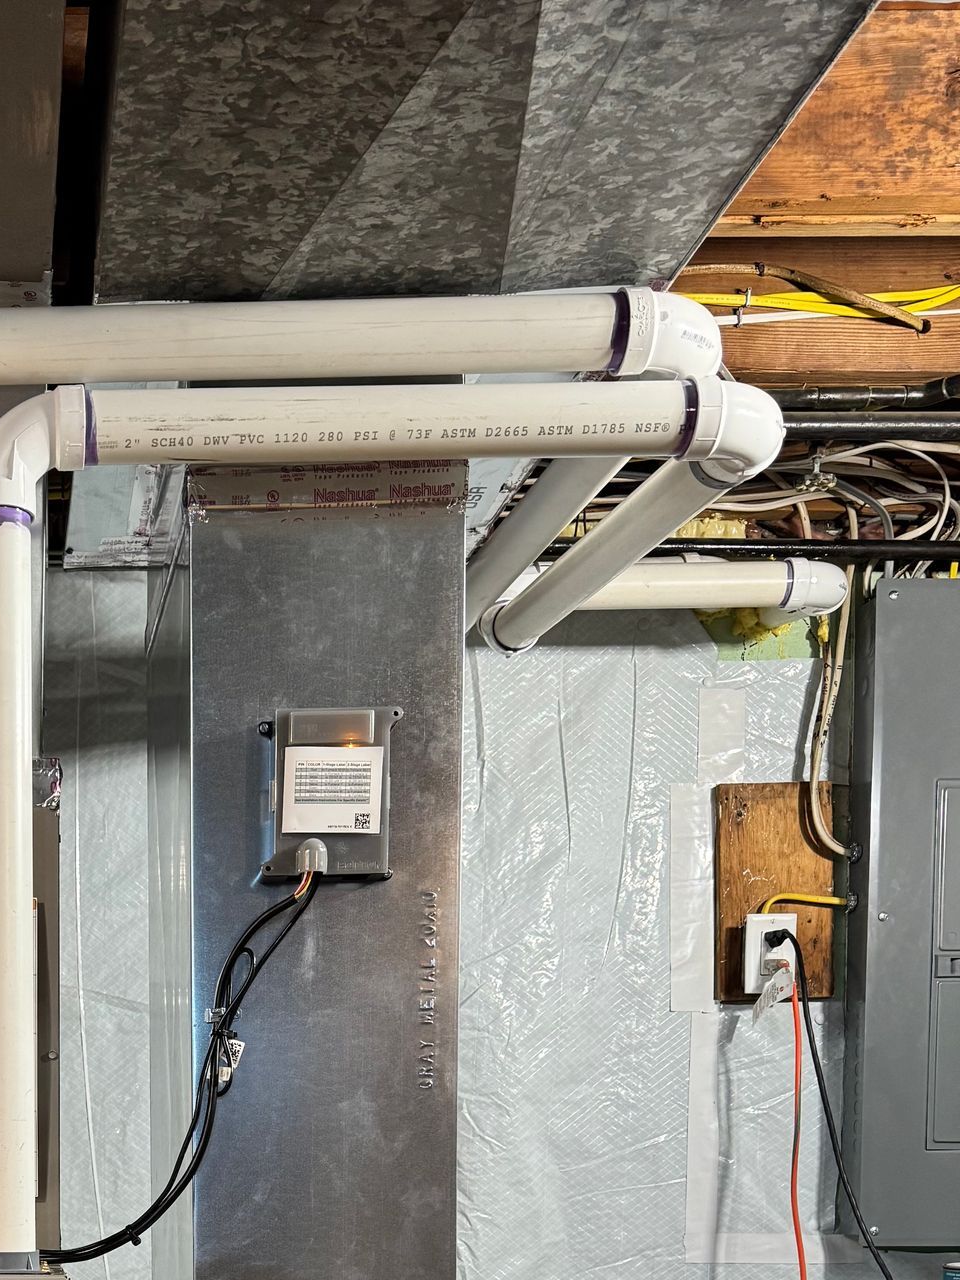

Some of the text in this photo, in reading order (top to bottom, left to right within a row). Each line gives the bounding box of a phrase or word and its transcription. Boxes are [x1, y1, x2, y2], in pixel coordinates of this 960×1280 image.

[150, 435, 194, 448] SCH40
[203, 435, 230, 446] DWV
[239, 433, 266, 445] PVC
[274, 432, 309, 444] 1120
[318, 431, 344, 443] 280
[353, 430, 380, 442] PSI
[406, 429, 433, 440] 73F
[440, 427, 477, 439] ASTM
[485, 426, 530, 438] D2665
[537, 425, 574, 436] ASTM
[582, 423, 626, 434] D1785
[313, 482, 453, 503] Nashua Nashua
[465, 486, 487, 509] USA
